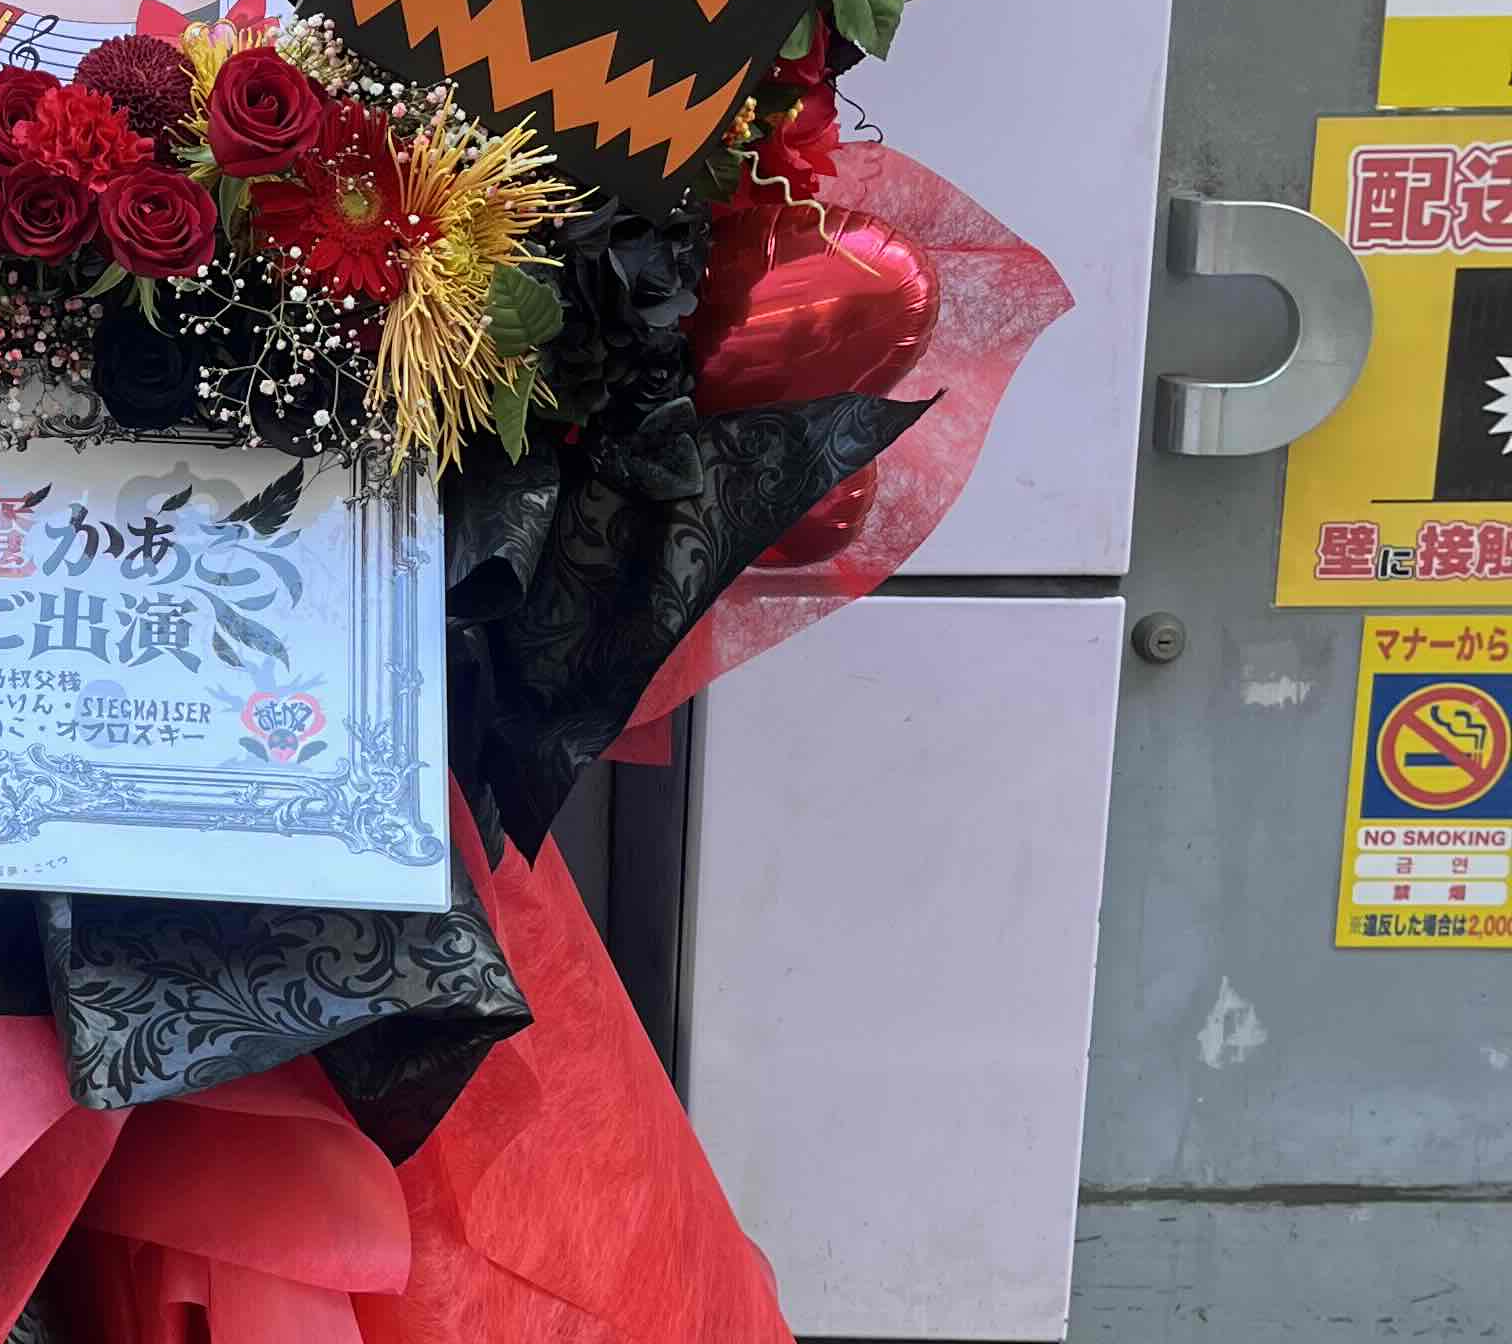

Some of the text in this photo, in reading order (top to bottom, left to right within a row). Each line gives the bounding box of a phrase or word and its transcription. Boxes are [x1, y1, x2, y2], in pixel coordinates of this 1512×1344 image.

[1374, 625, 1510, 663] マナーから
[1364, 829, 1506, 846] NO SMOKING
